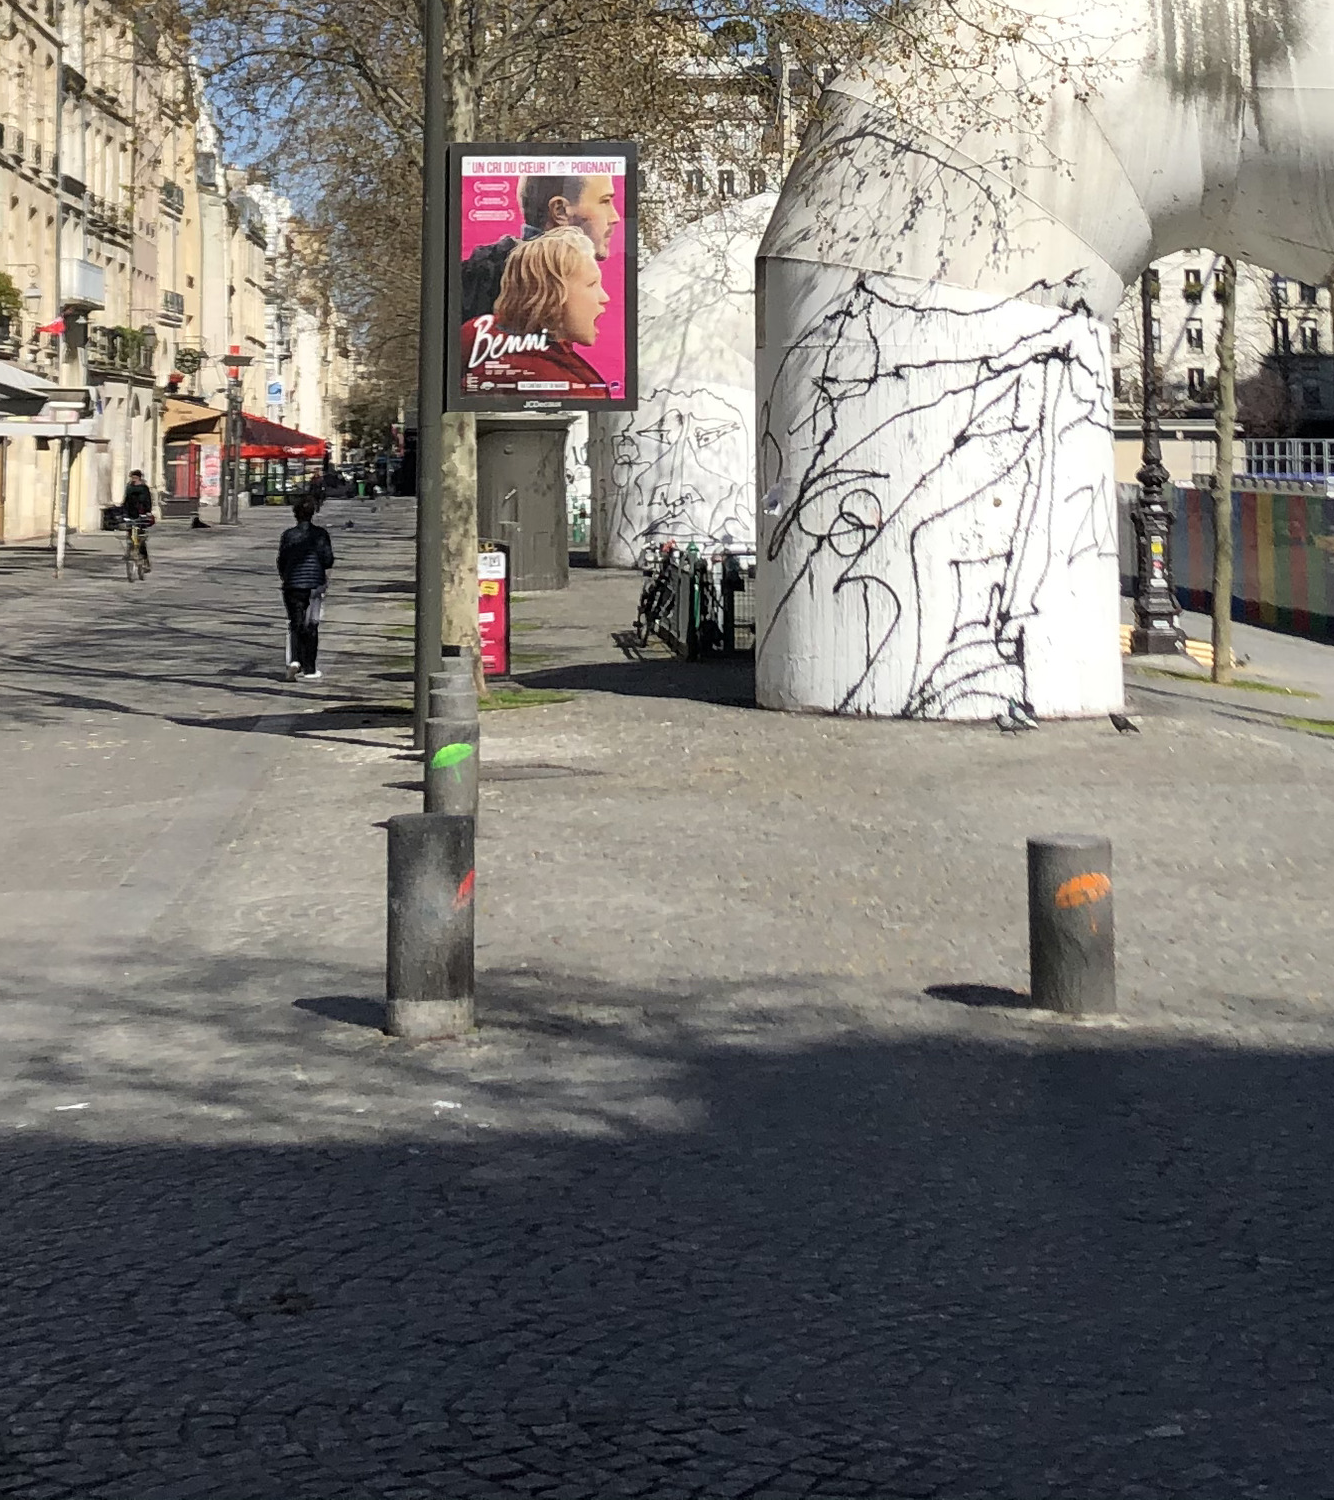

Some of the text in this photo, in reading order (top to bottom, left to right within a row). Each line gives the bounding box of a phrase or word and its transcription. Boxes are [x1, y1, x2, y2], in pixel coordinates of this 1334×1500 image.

[472, 162, 485, 173] UN
[487, 162, 502, 173] CRI
[504, 162, 517, 173] DU
[571, 162, 617, 173] POIGNANT
[468, 314, 550, 368] Benni
